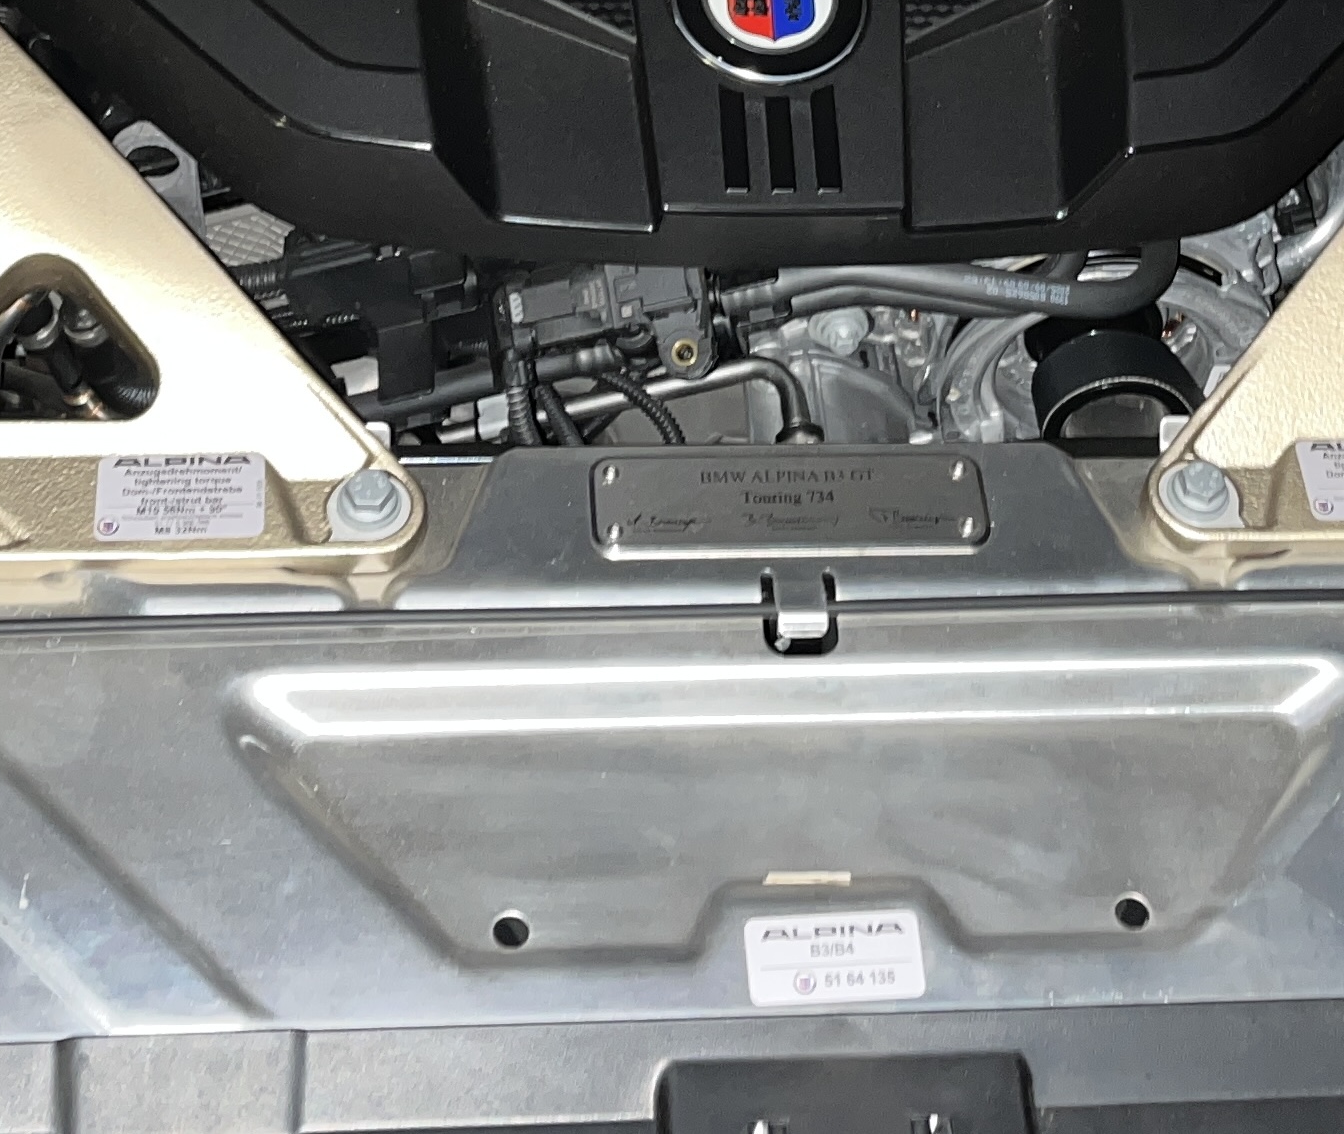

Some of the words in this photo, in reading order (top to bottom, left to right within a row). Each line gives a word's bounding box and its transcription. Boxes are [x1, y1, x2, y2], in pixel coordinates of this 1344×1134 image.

[113, 456, 250, 468] ALPINA
[134, 476, 192, 488] tightening
[194, 476, 232, 487] torque
[700, 470, 746, 485] BMW
[750, 470, 819, 484] ALPINA
[849, 468, 876, 482] GT
[205, 496, 223, 505] bar
[740, 490, 802, 506] Touring
[805, 489, 835, 504] 734
[761, 923, 903, 942] ALPINA
[810, 943, 854, 958] B3/B4
